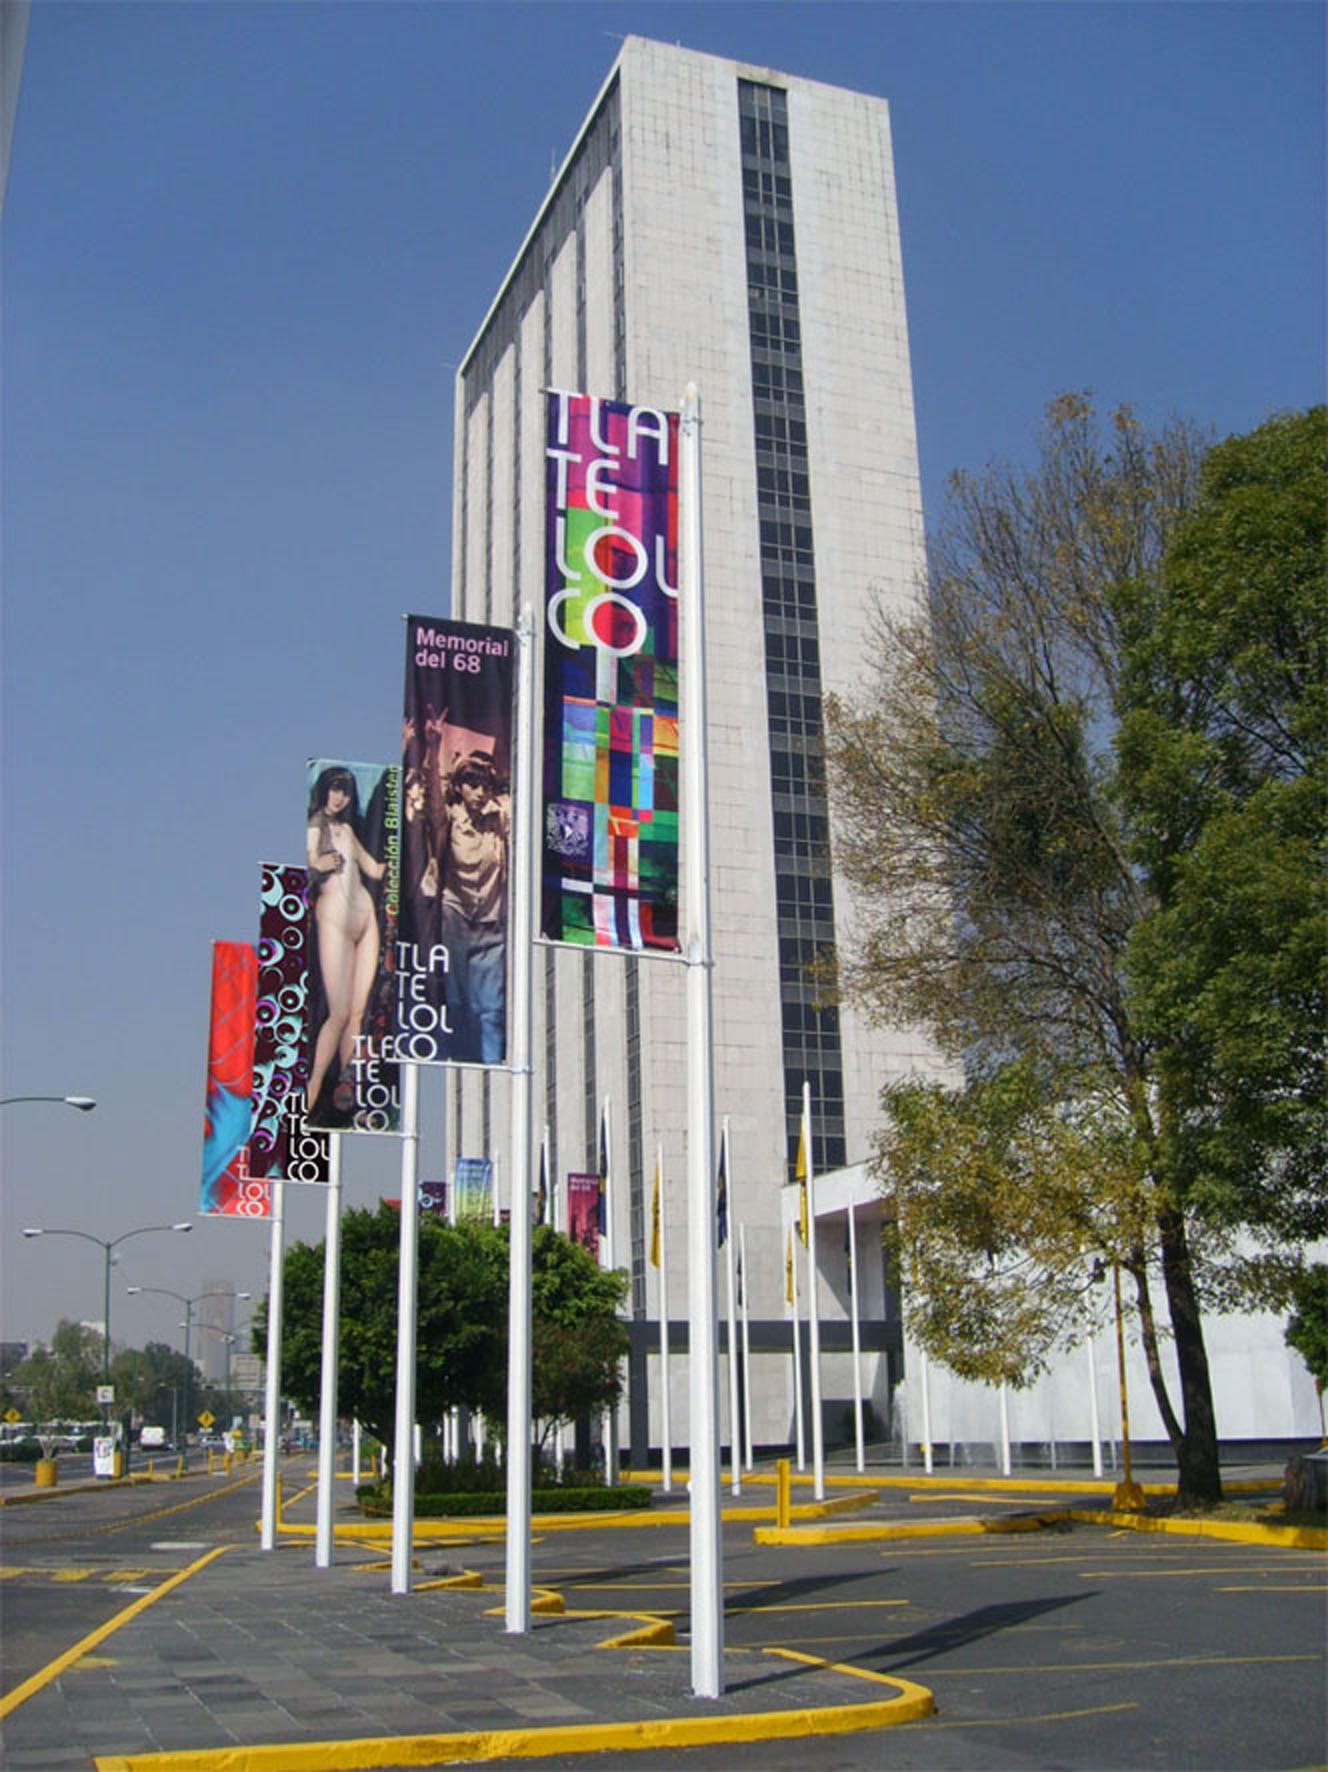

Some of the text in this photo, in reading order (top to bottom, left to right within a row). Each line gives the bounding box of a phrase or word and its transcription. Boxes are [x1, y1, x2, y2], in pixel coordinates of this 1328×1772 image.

[546, 386, 669, 465] TLA
[546, 448, 620, 519] TE
[547, 588, 648, 657] CO
[416, 626, 509, 656] Memorial
[415, 648, 481, 673] del 68
[396, 941, 449, 973] TLA
[395, 971, 427, 1001] TE
[398, 1002, 453, 1034] LOL
[394, 1033, 438, 1061] CO
[352, 1059, 380, 1083] TE
